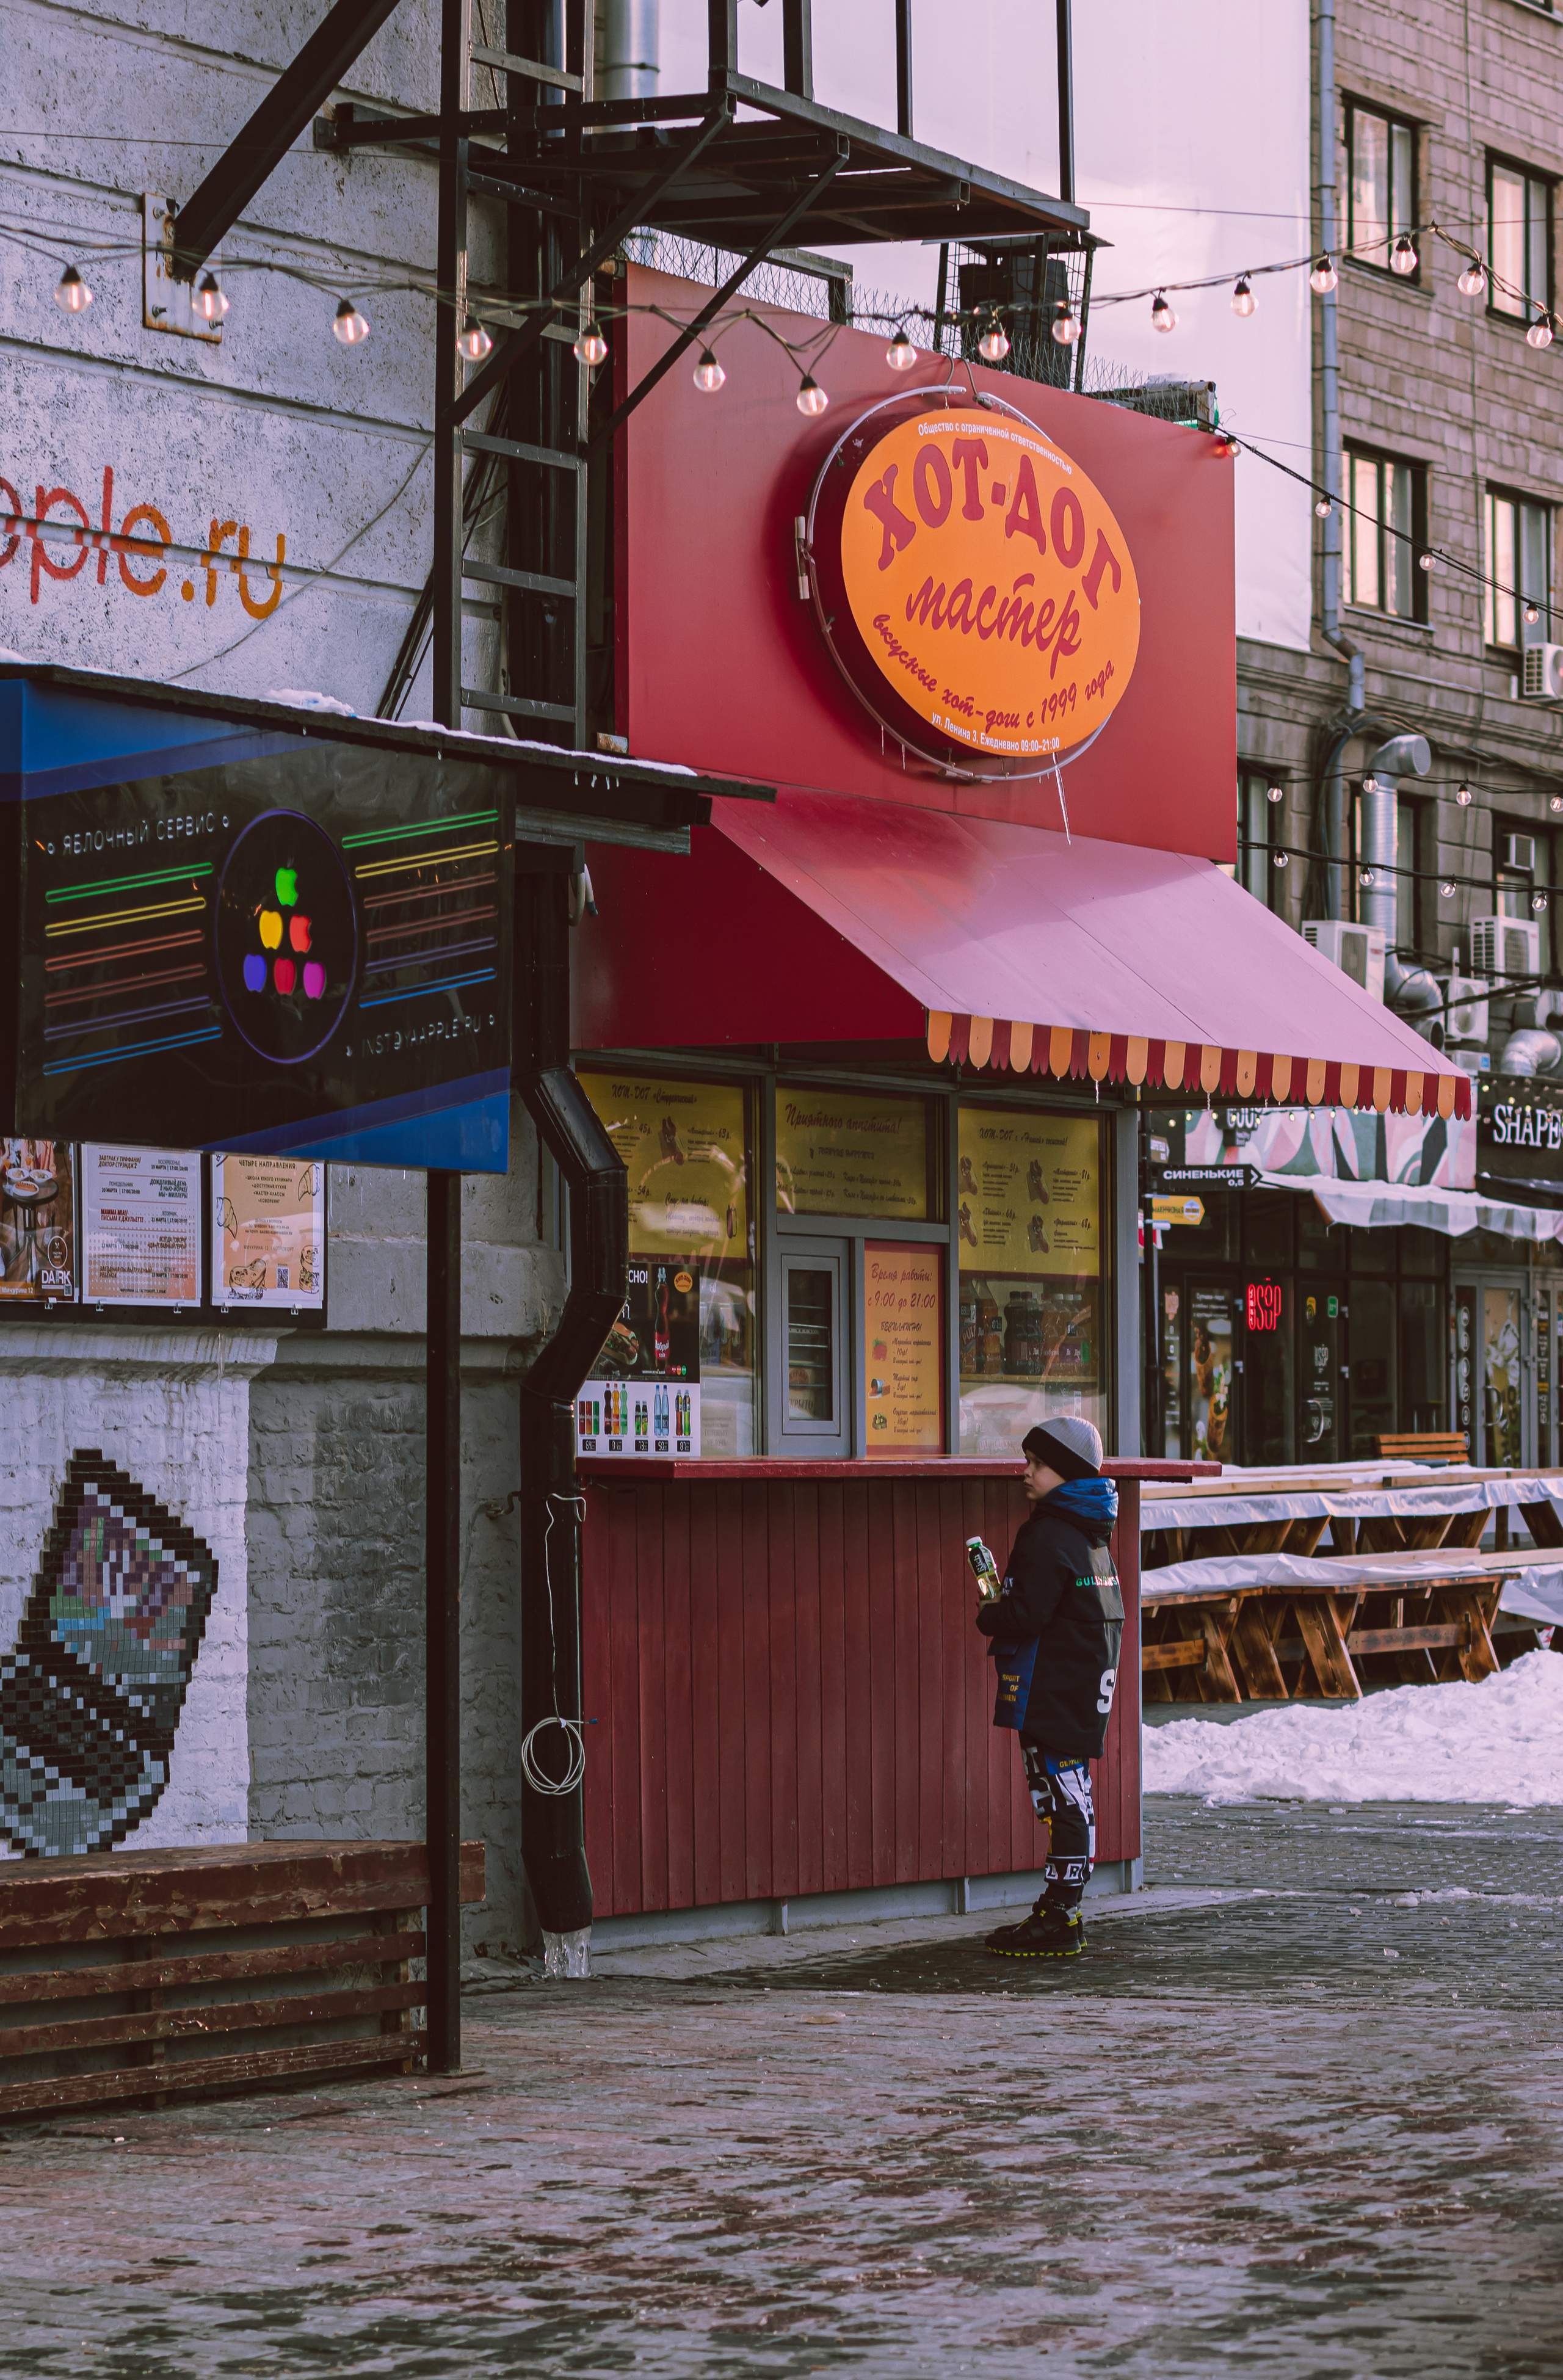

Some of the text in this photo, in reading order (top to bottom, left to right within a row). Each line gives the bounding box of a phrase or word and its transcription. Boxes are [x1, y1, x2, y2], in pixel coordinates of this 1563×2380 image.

[918, 423, 954, 436] Общество
[961, 424, 1009, 441] ограниченной
[1010, 432, 1072, 475] ответственностью
[863, 438, 1122, 610] ХОТ-ДОГ
[905, 573, 1082, 680] мастер
[872, 614, 1115, 733] вкусные хот-доги с 1999 года
[932, 712, 944, 727] ул.
[944, 715, 971, 740] Ленина
[980, 733, 1019, 752] Ежедневно
[62, 812, 214, 855] ЯБЛОЧНЫЙ СЕРВИС
[785, 1103, 902, 1134] Приятного аппетита!
[1493, 1104, 1563, 1149] SHAPE
[1163, 1169, 1244, 1180] СИНЕНЬКИЕ
[871, 1263, 932, 1285] Время работы:
[874, 1290, 895, 1307] 9:00
[898, 1298, 907, 1313] до
[910, 1293, 936, 1308] 21:00
[881, 1321, 923, 1333] БЕСПЛАТНО!
[974, 1554, 984, 1573] Rich
[1002, 1674, 1020, 1683] SPORT
